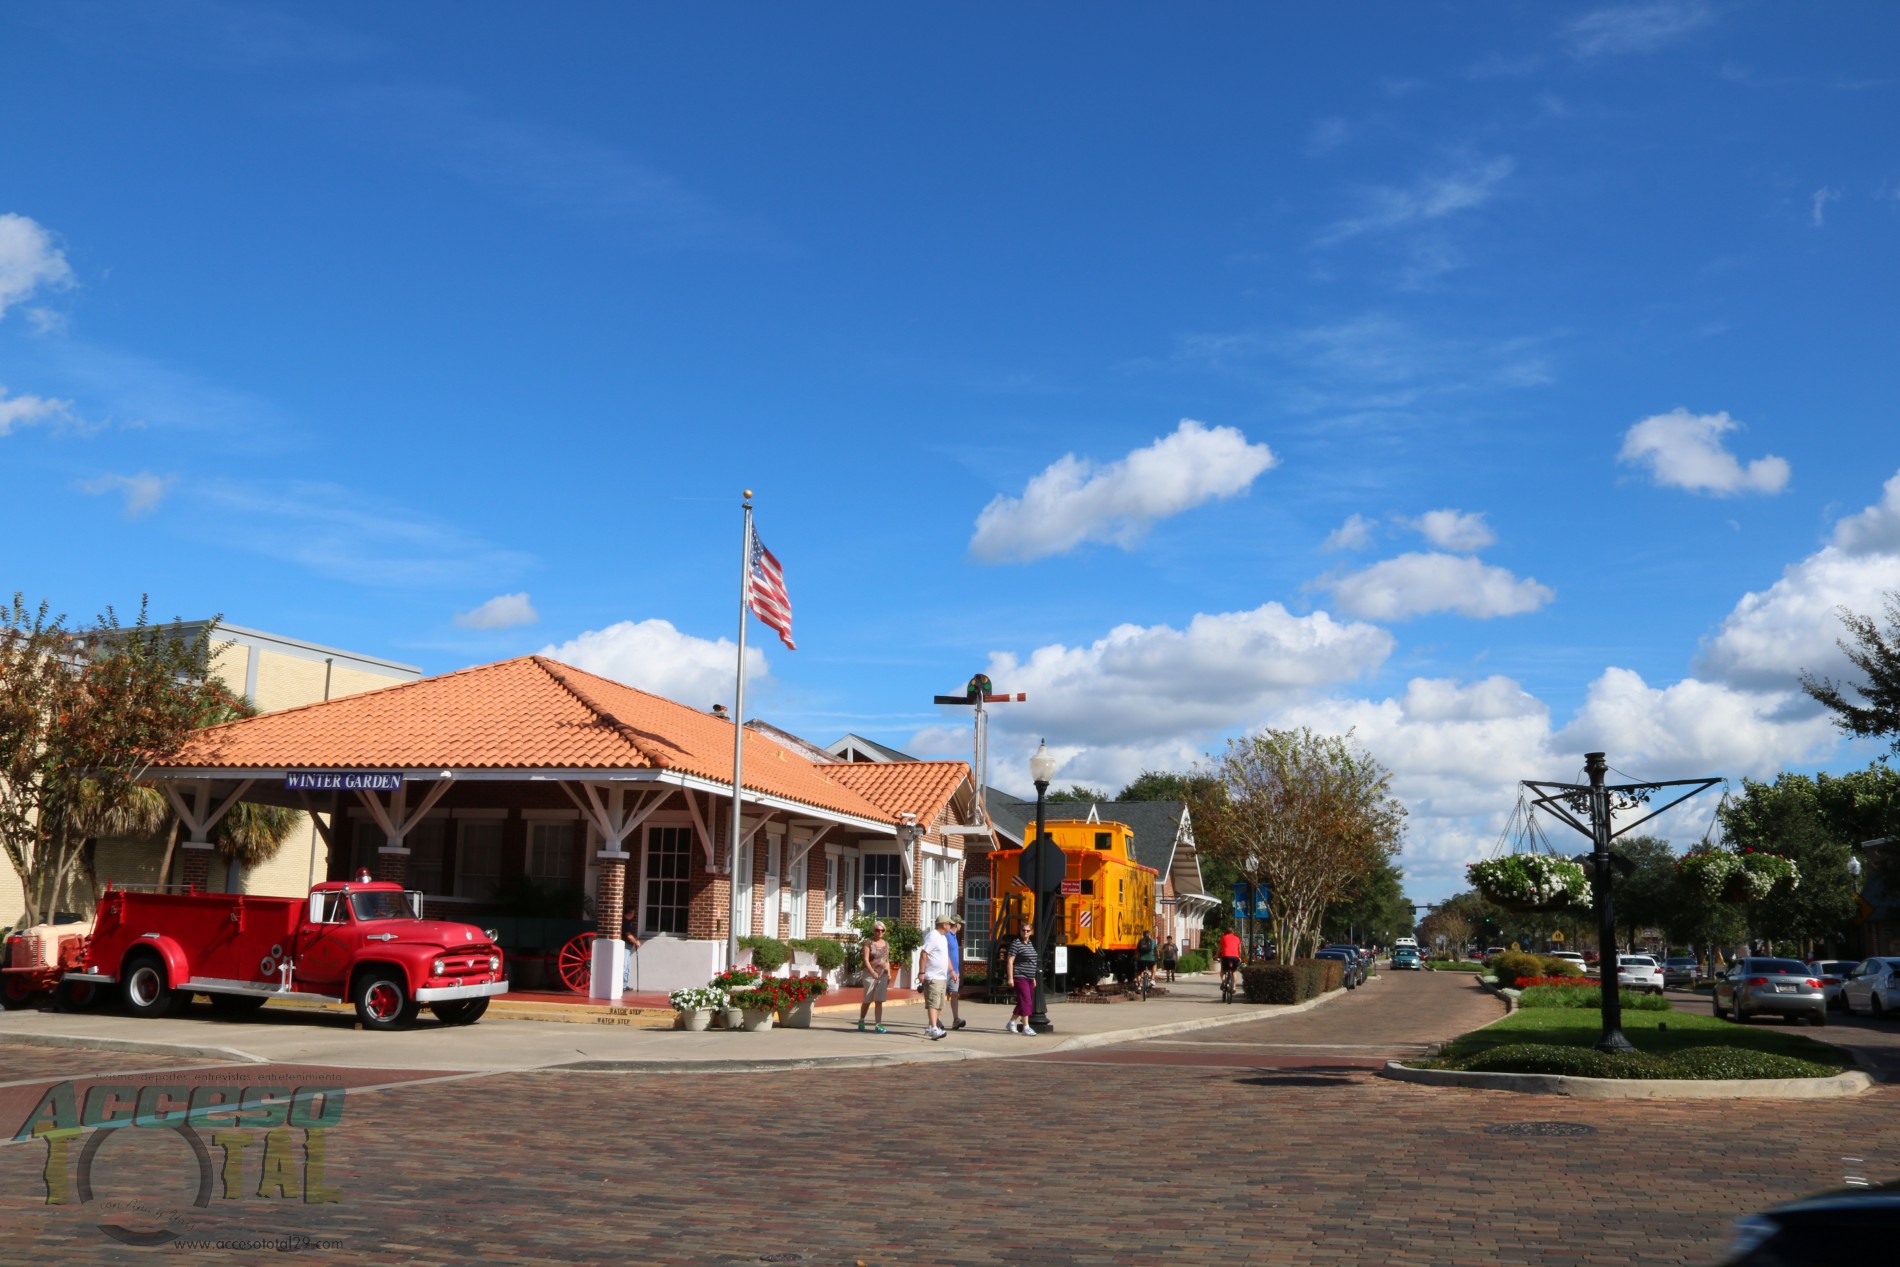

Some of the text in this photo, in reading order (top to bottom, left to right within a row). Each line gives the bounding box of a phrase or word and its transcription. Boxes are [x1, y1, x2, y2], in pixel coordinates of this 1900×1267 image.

[287, 773, 401, 789] WINTER GARDEN
[629, 1008, 642, 1016] STEP
